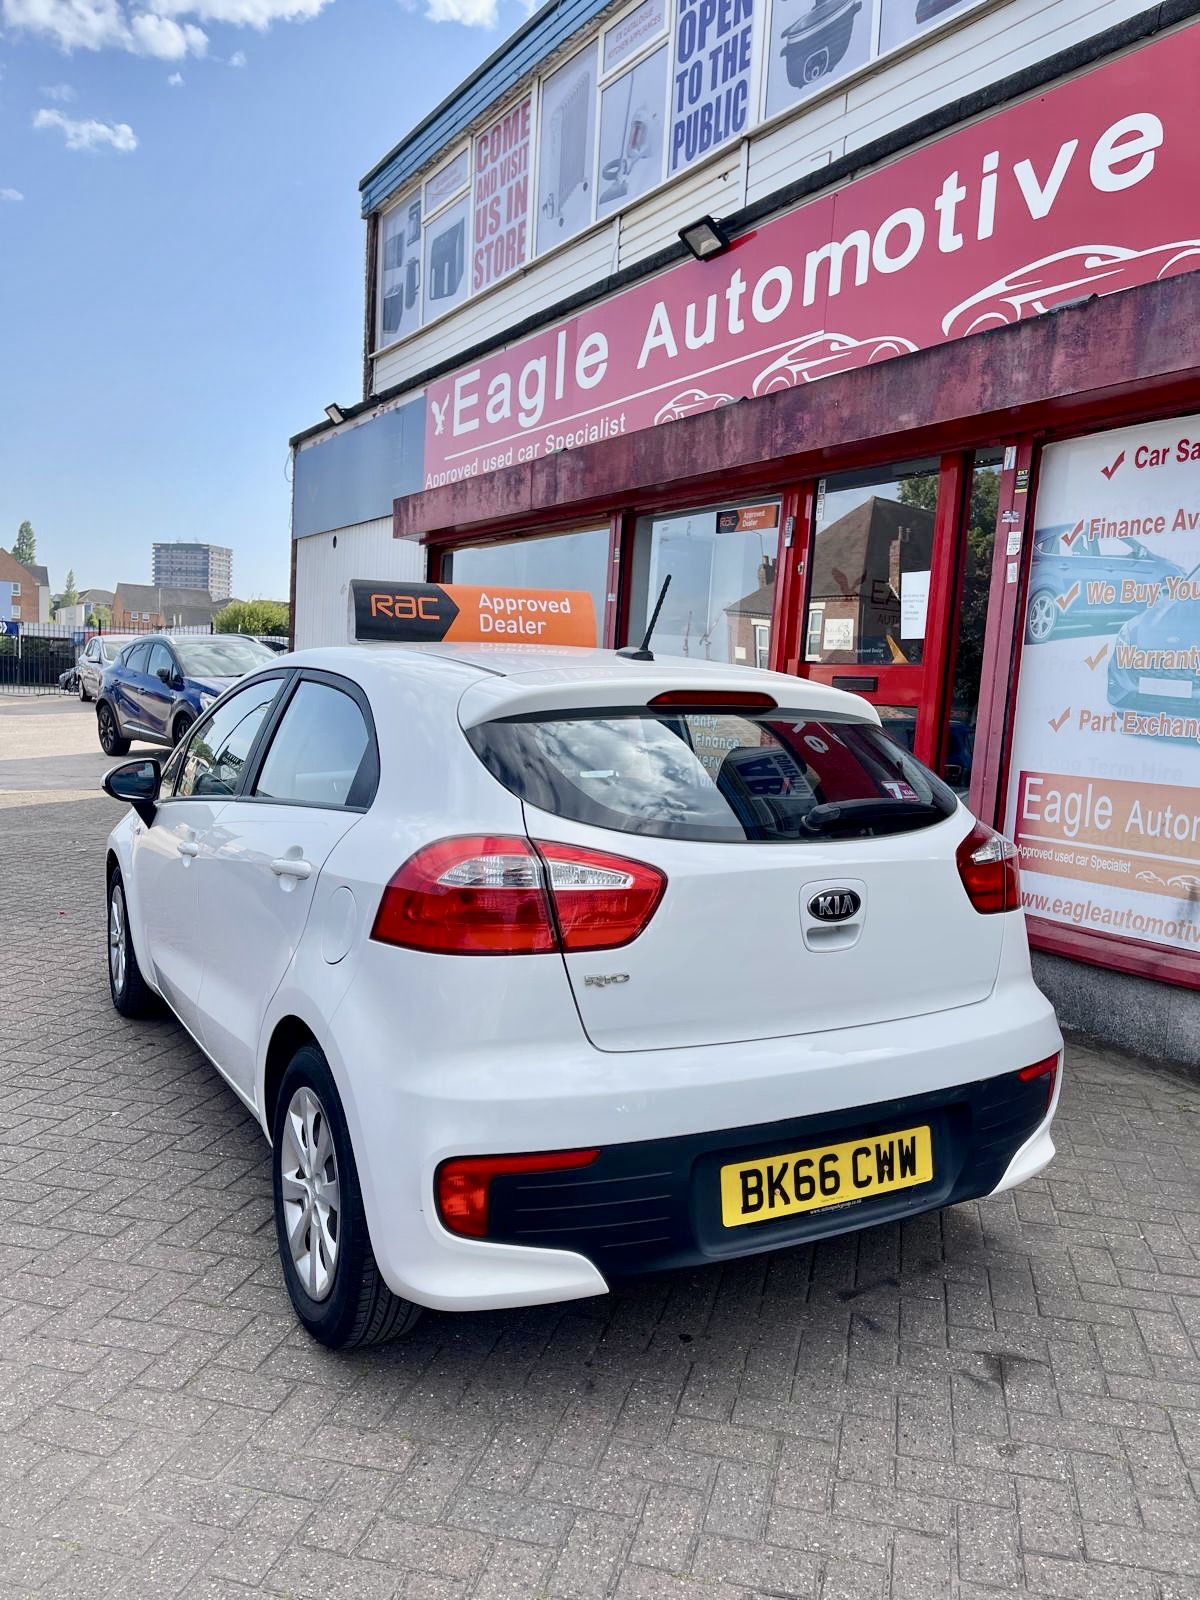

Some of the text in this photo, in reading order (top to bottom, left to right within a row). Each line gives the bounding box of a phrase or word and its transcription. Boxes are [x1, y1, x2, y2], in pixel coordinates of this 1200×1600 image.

[677, 0, 752, 65] OPEN
[676, 24, 752, 113] TO THE
[477, 101, 531, 174] COME
[672, 79, 748, 171] PUBLIC
[476, 166, 497, 205] AND
[500, 142, 529, 188] VISIT
[475, 194, 501, 244] US
[506, 174, 529, 225] IN
[452, 112, 1164, 437] Eagle Automotive
[474, 220, 526, 290] STORE
[425, 411, 626, 491] Approved used car Specialist
[1134, 438, 1200, 469] Car Sa
[1089, 508, 1200, 541] Finance Av
[478, 593, 571, 615] Approved
[479, 613, 547, 635] Dealer
[1087, 582, 1115, 605] We
[1120, 579, 1161, 608] Buy
[695, 732, 741, 750] Finance
[1078, 709, 1200, 741] Part Exchan
[1022, 776, 1114, 838] Eagle
[1017, 843, 1132, 874] Approved used car Specialist
[818, 894, 854, 916] KIA
[584, 973, 631, 988] RIO
[739, 1135, 917, 1215] BK66 CWW
